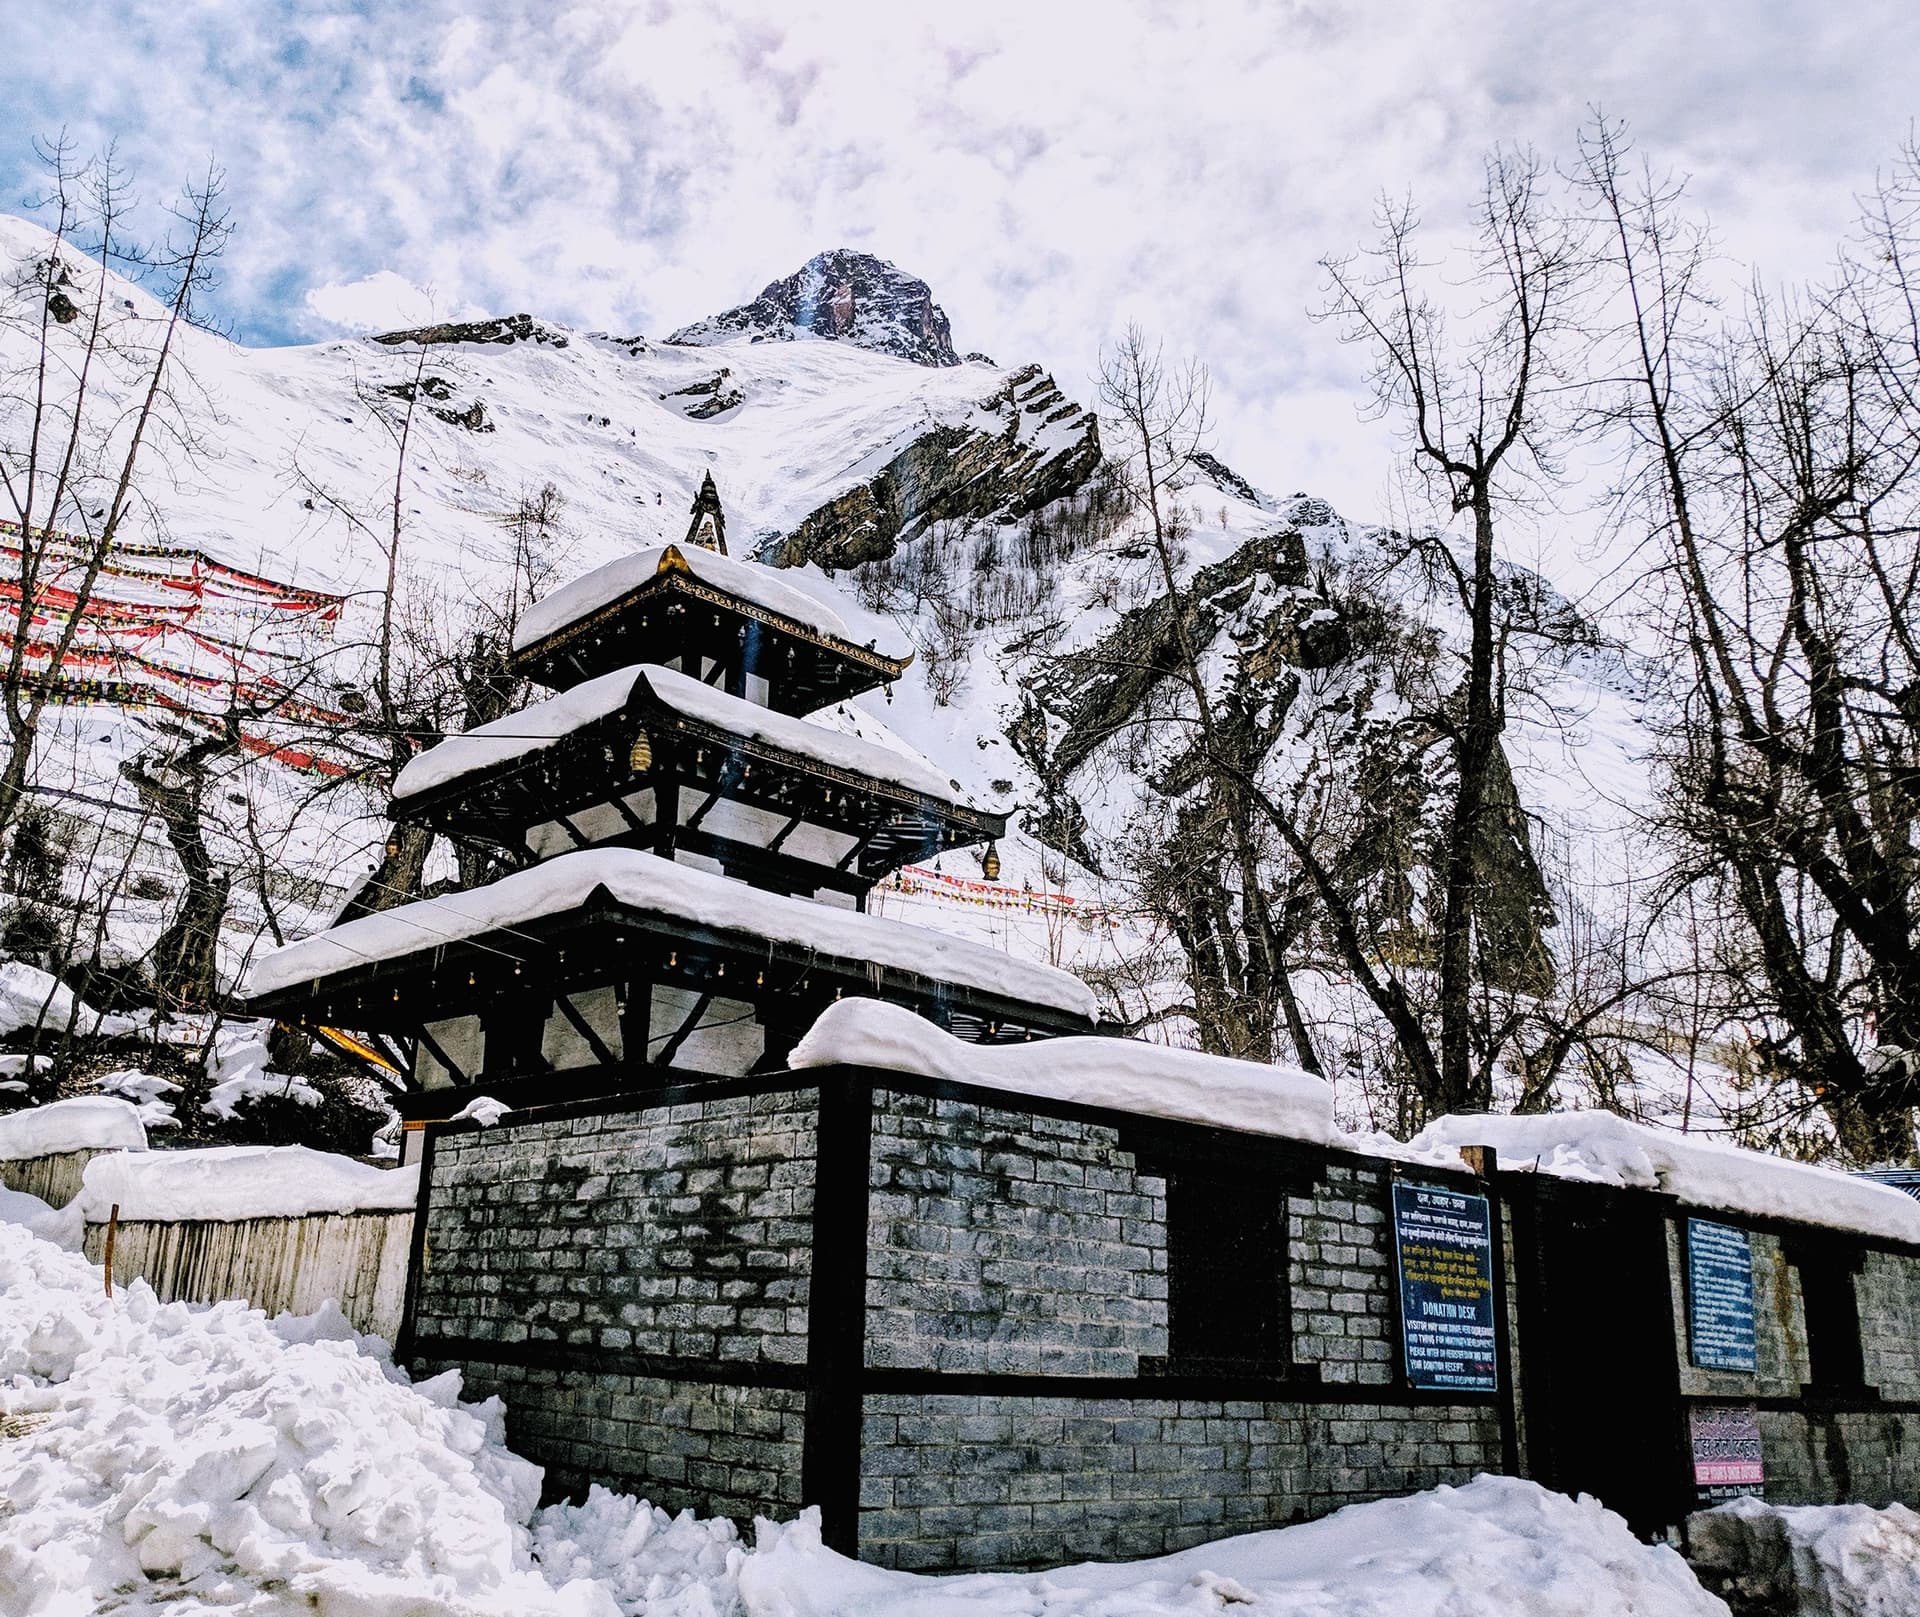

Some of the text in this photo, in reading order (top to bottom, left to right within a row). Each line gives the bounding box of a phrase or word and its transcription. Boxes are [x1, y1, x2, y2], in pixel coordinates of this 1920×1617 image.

[1423, 1301, 1477, 1320] DONATION DESK
[1406, 1320, 1427, 1331] VISITOR
